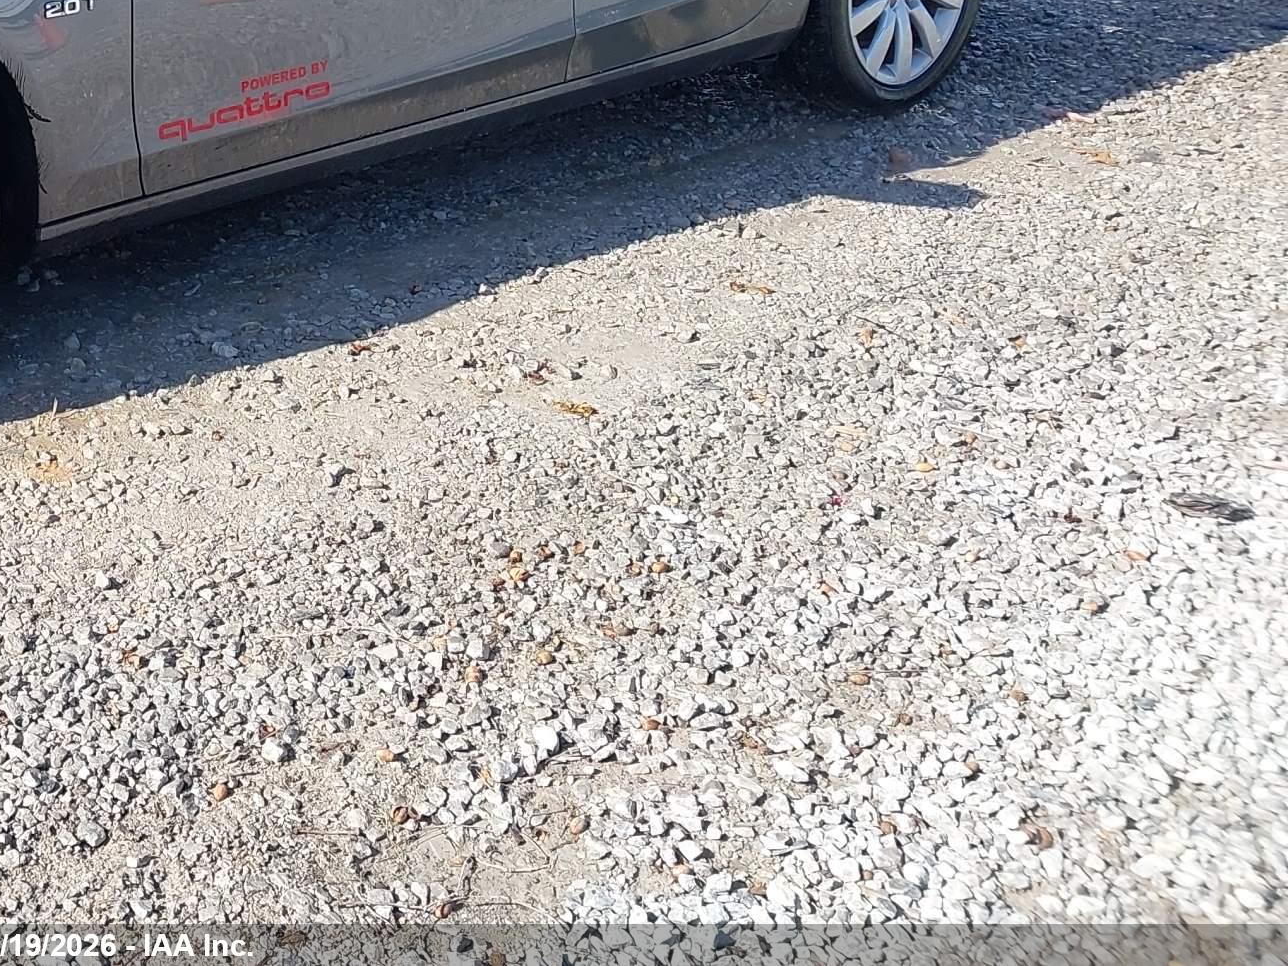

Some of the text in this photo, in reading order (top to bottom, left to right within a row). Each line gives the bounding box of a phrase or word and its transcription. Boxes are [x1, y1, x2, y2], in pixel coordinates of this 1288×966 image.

[240, 60, 330, 94] POWERED BY
[158, 80, 331, 142] quattro
